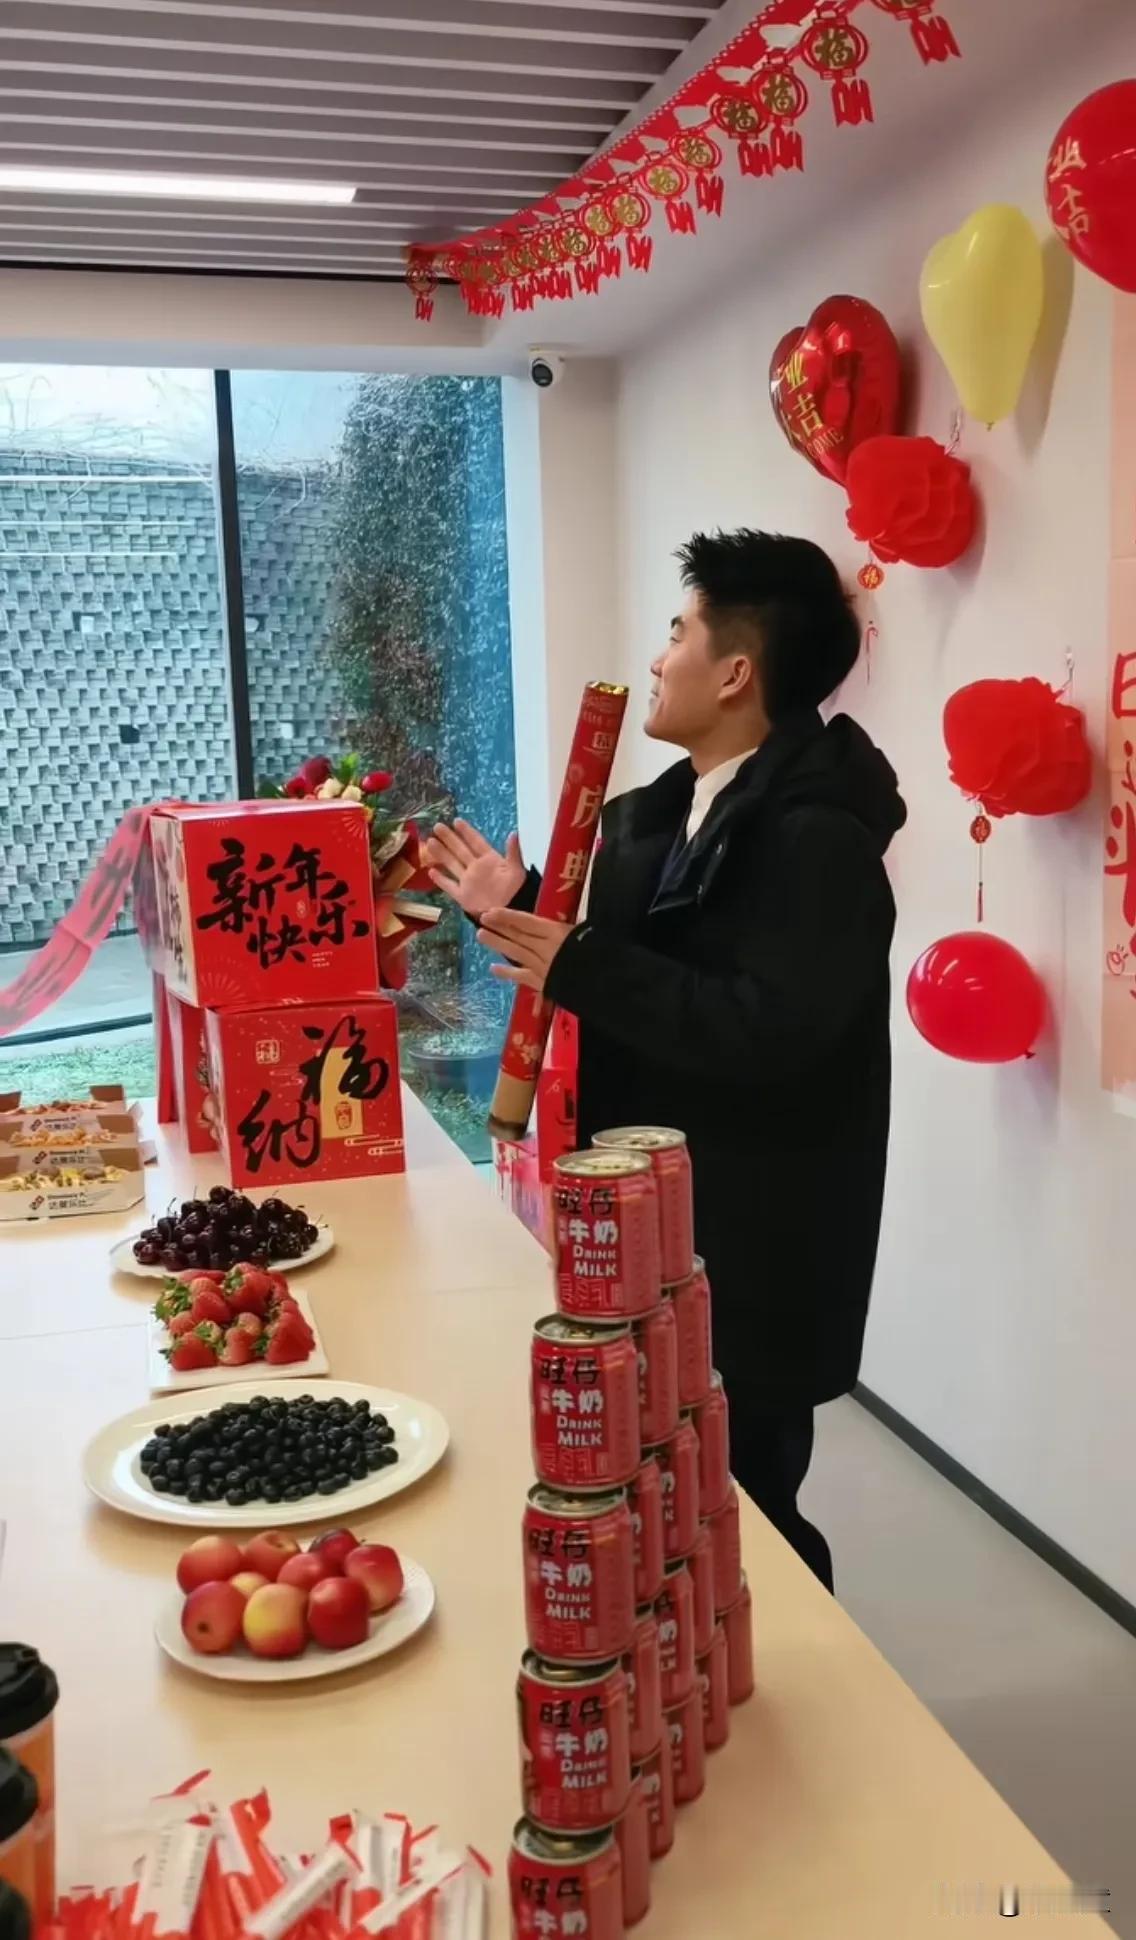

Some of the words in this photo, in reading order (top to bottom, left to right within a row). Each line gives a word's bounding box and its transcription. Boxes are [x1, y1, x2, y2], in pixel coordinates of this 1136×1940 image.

[814, 28, 855, 70] 福
[762, 75, 796, 116] 福
[568, 1219, 619, 1244] 牛奶
[574, 1261, 617, 1276] MILK
[551, 1389, 604, 1414] 牛奶
[557, 1431, 602, 1446] MILK
[540, 1560, 592, 1587] 牛奶
[546, 1603, 591, 1619] MILK
[556, 1728, 608, 1756] 牛奶
